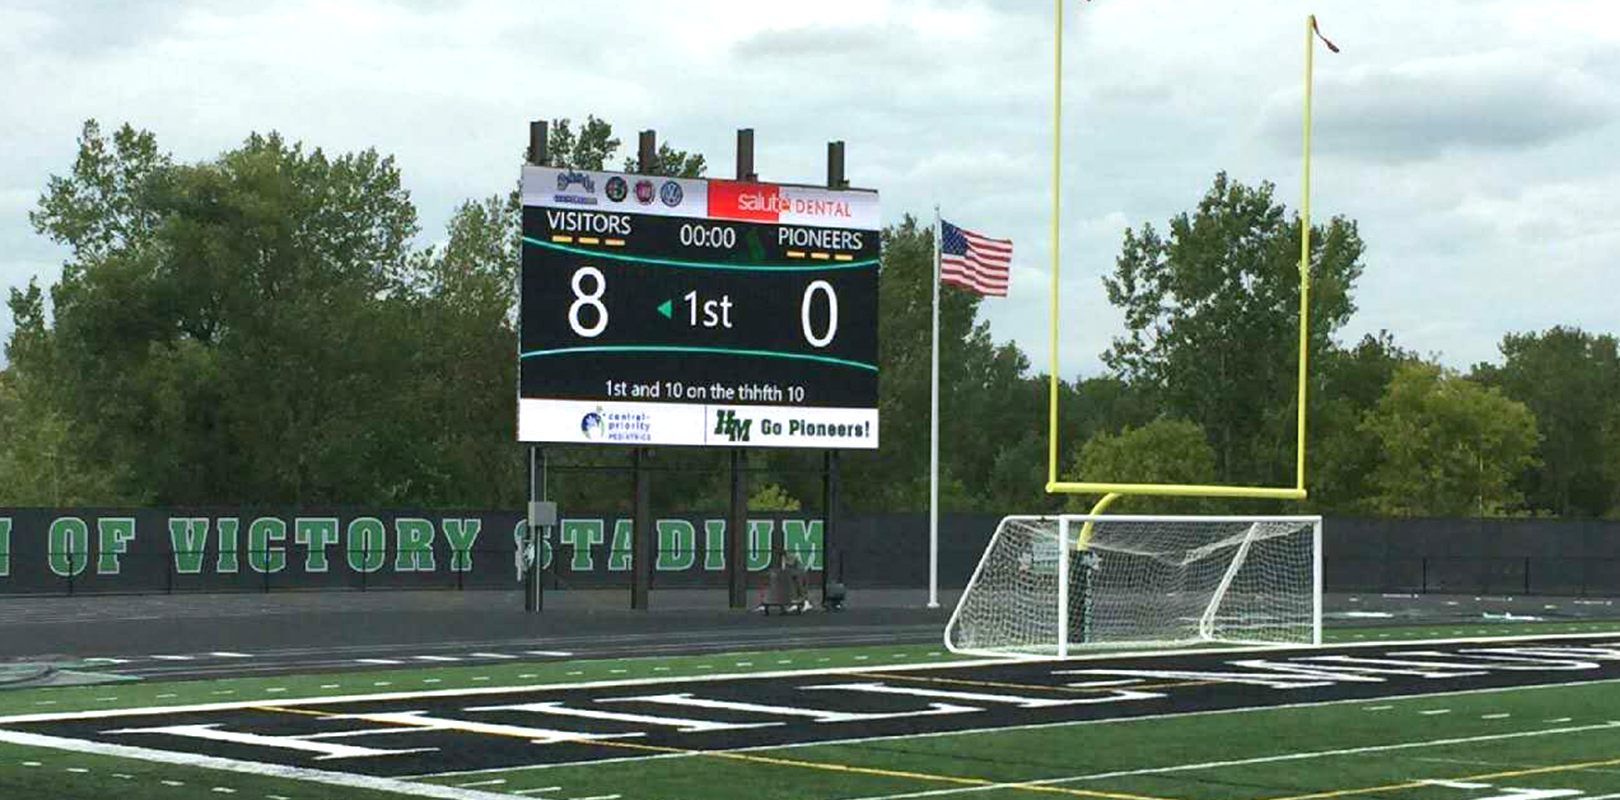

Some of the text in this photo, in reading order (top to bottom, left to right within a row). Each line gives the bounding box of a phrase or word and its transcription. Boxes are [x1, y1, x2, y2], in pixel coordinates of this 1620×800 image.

[795, 200, 852, 218] DENTAL
[546, 210, 632, 235] VISITORS
[680, 223, 736, 250] 00:00
[778, 227, 863, 250] PIONEERS
[568, 266, 609, 338] 8
[684, 289, 733, 329] 1st
[801, 280, 838, 348] 0
[605, 380, 627, 397] 1st
[632, 381, 660, 398] and
[665, 382, 683, 399] 10
[687, 386, 706, 399] on
[710, 384, 735, 401] the
[787, 386, 805, 402] 10
[761, 418, 871, 438] Go Pioneers!
[48, 517, 136, 577] OF
[168, 517, 482, 574] VICTORY
